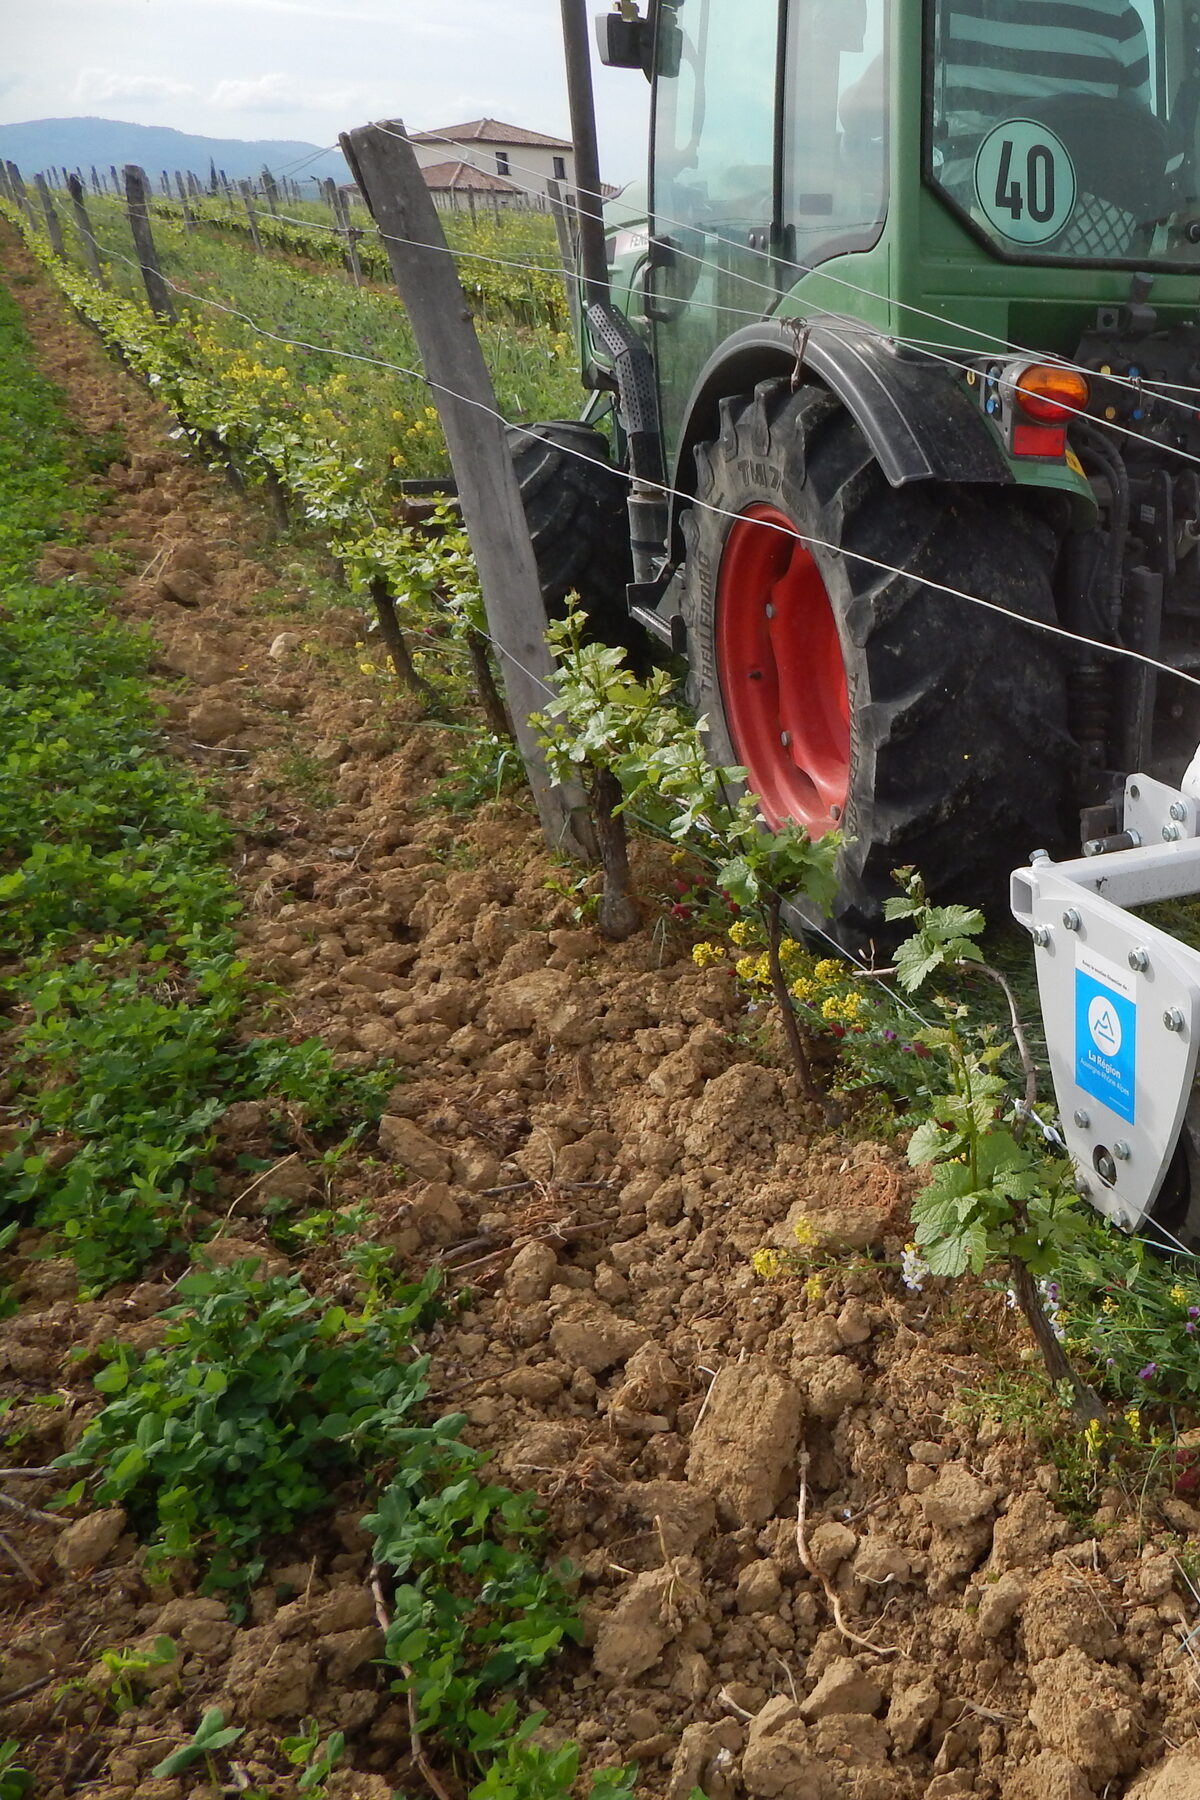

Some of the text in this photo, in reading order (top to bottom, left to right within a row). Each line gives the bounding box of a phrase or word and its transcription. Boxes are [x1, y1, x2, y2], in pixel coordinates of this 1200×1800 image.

[995, 140, 1055, 223] 40
[698, 550, 713, 692] TRELLEBORG
[1088, 1049, 1121, 1079] La Région
